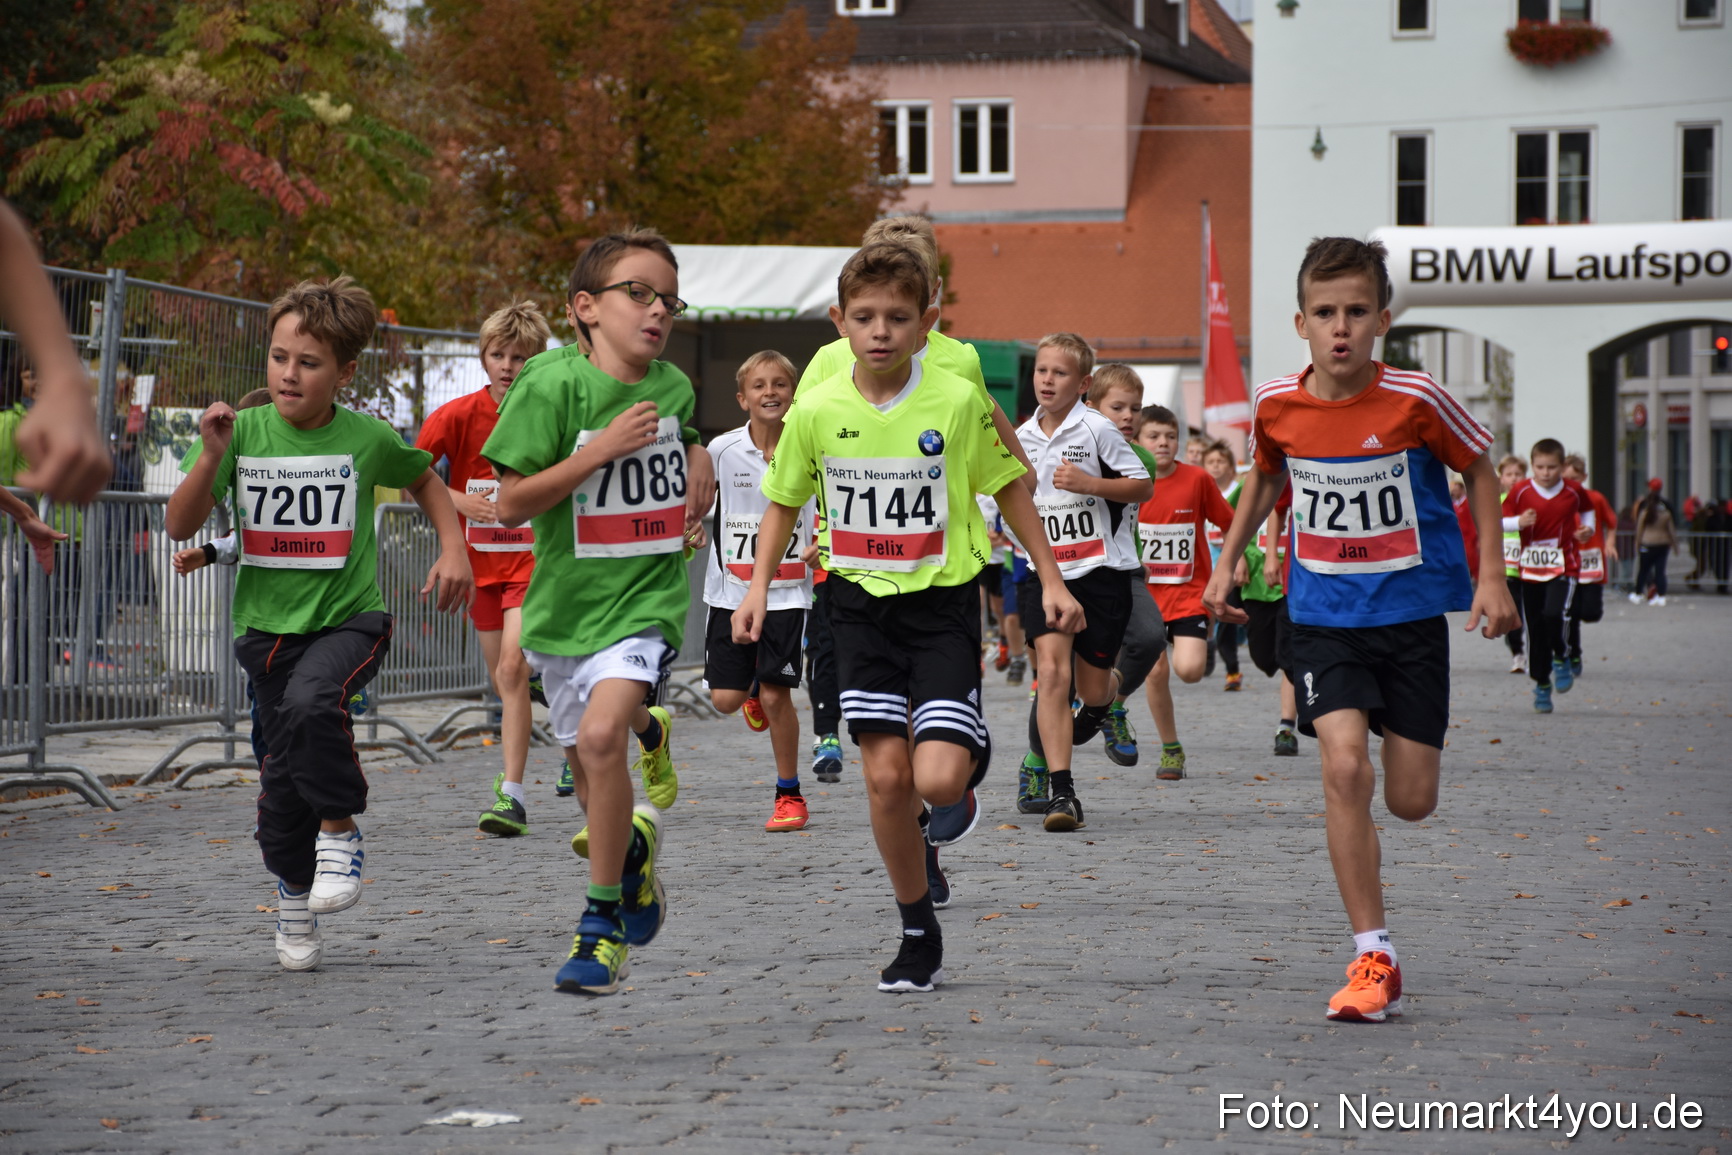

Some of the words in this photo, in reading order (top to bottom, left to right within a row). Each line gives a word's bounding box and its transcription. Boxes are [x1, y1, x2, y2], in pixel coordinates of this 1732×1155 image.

[1411, 247, 1533, 282] BMW
[1548, 243, 1732, 285] Laufspo
[1062, 450, 1090, 458] MÜNCH
[238, 467, 275, 480] PARTL
[277, 468, 336, 480] Neumarkt
[596, 449, 686, 508] 7083
[826, 466, 861, 480] PARTL
[864, 468, 923, 481] Neumarkt
[1292, 468, 1325, 485] PARTL
[1326, 470, 1388, 486] Neumarkt
[733, 480, 753, 488] Lukas
[246, 484, 346, 527] 7207
[836, 485, 936, 528] 7144
[1048, 501, 1084, 511] Neumarkt
[1302, 484, 1404, 532] 7210
[631, 518, 666, 538] Tim
[726, 521, 753, 529] PARTL
[491, 531, 523, 542] Julius
[270, 537, 326, 554] Jamiro
[867, 539, 904, 557] Felix
[1338, 543, 1368, 559] Jan
[1054, 549, 1077, 560] Luca
[1526, 550, 1560, 566] 7002
